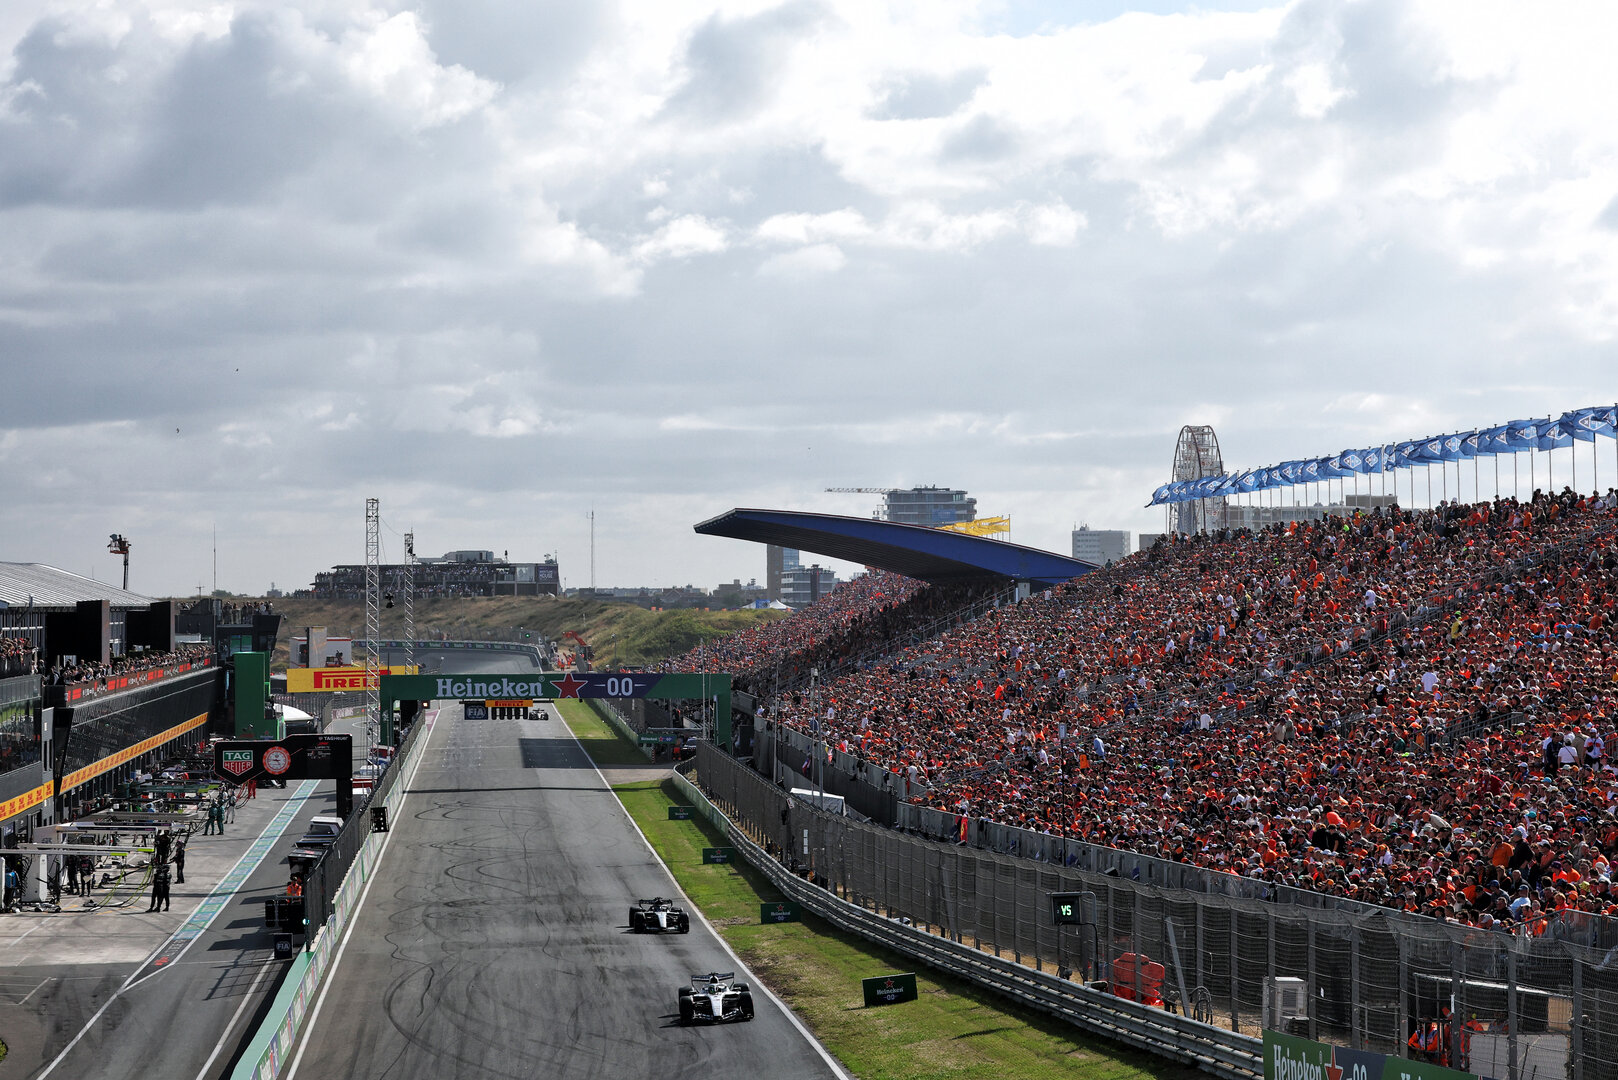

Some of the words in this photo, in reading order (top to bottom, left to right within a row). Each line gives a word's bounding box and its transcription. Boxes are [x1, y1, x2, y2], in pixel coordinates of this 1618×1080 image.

[313, 670, 391, 689] PIREL
[436, 678, 543, 697] Heineken
[225, 752, 251, 760] TAG
[224, 762, 252, 774] HEUER
[1061, 905, 1072, 916] VS
[876, 987, 904, 995] Heineken
